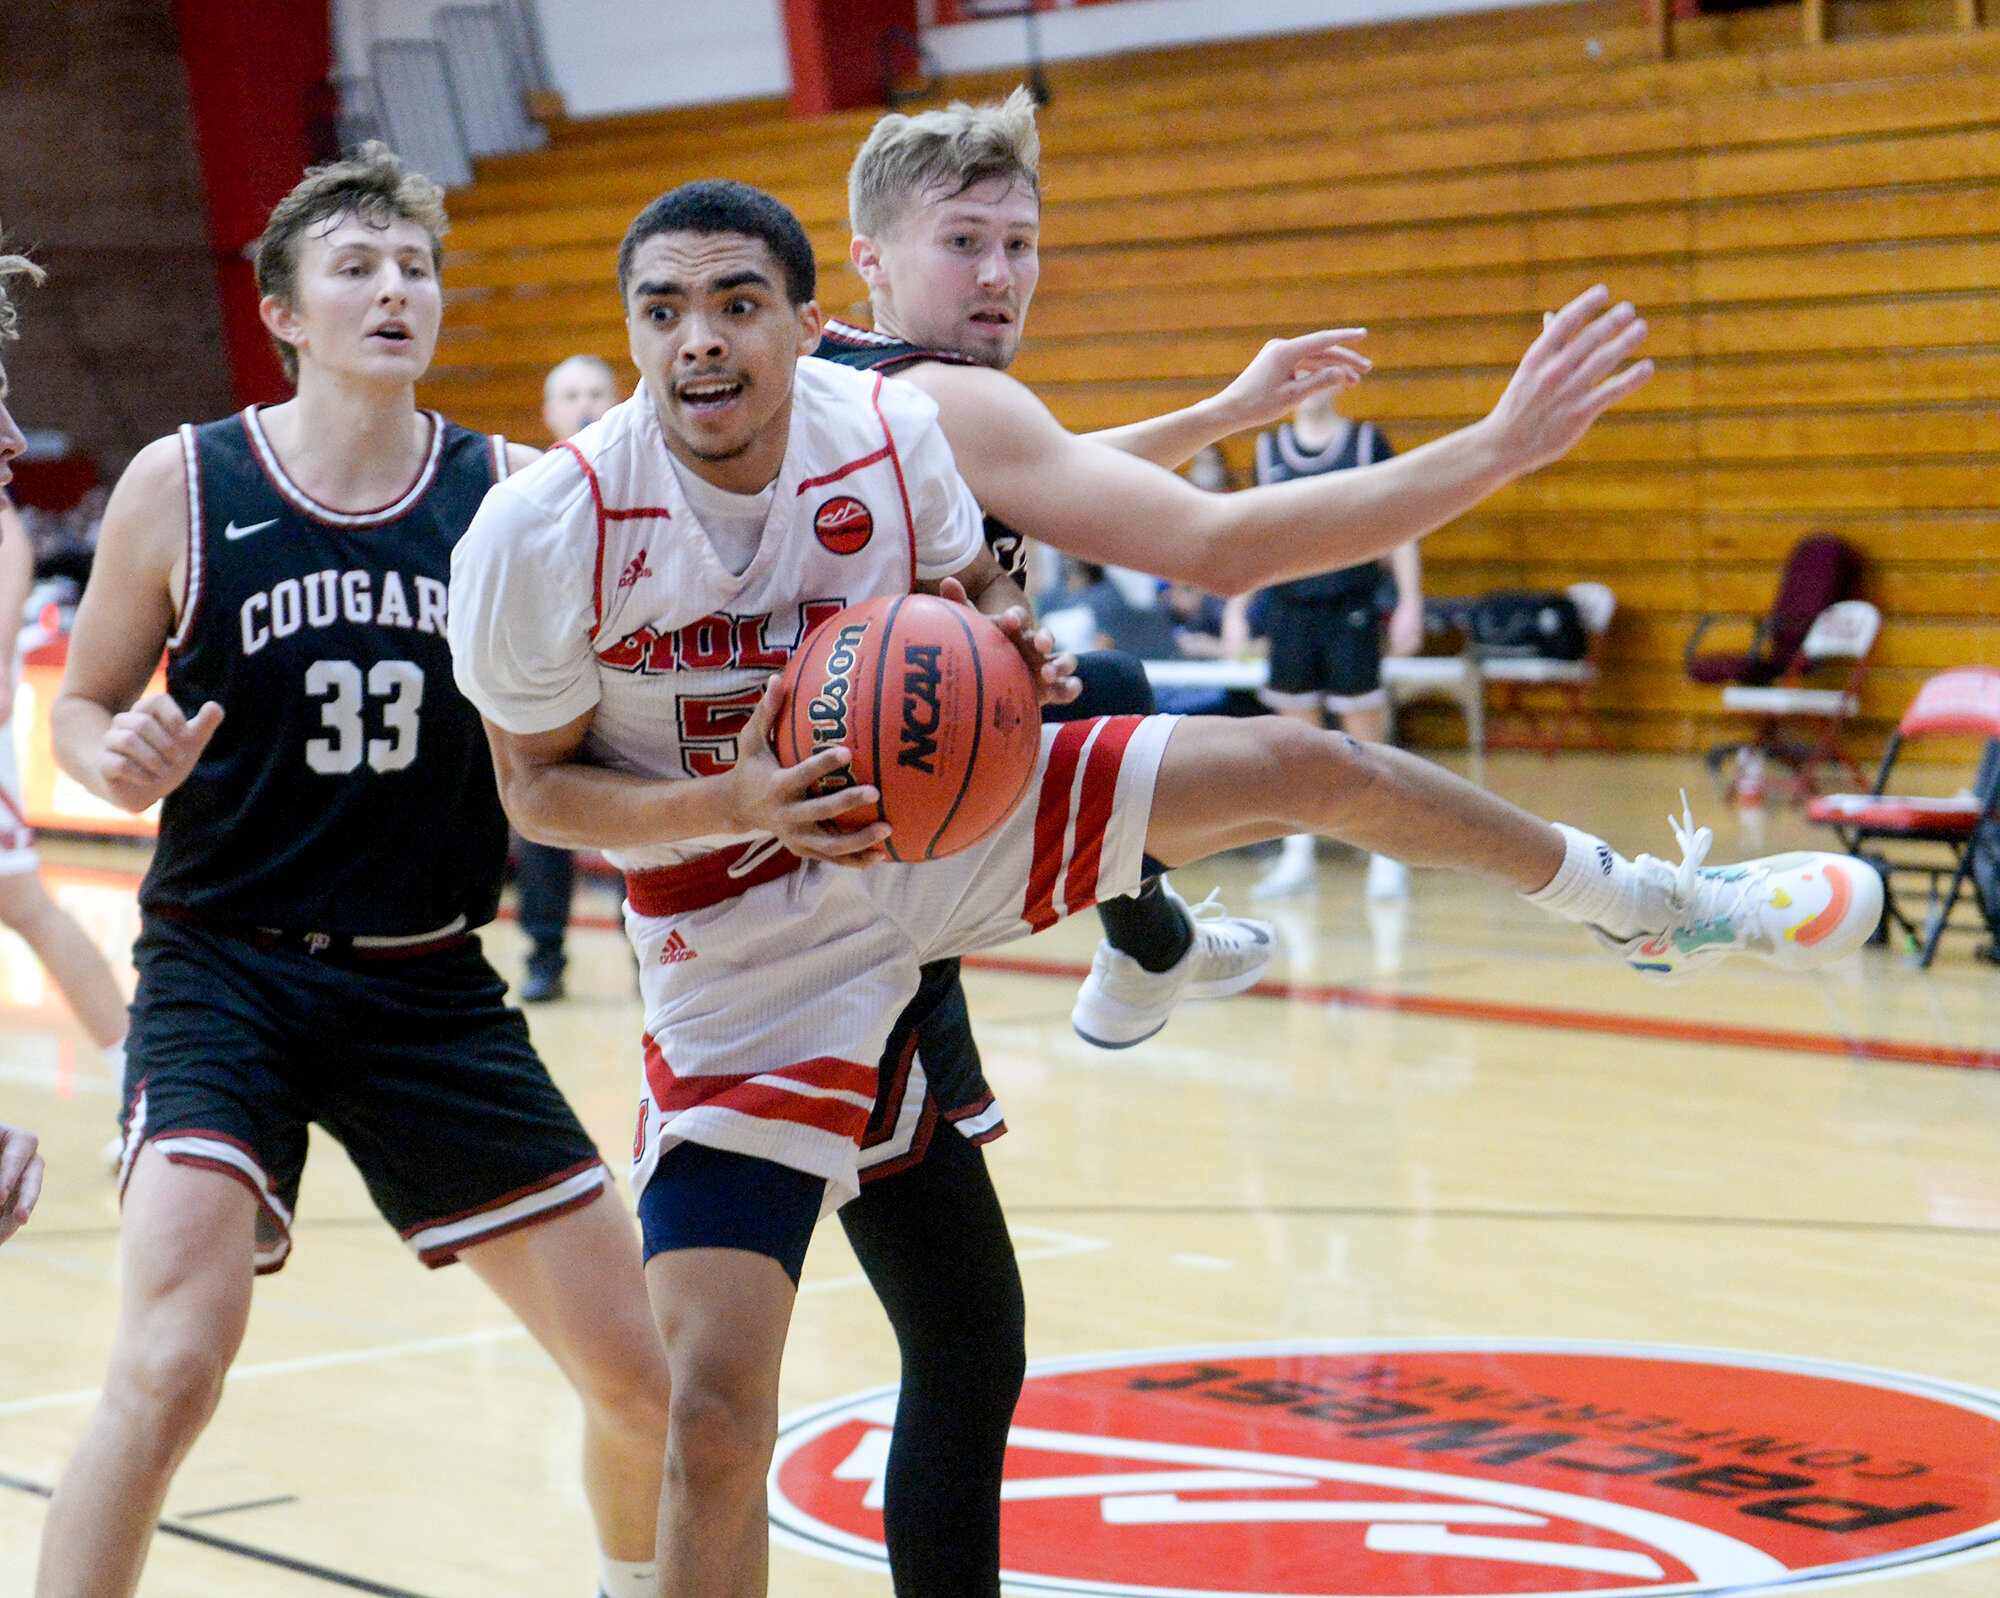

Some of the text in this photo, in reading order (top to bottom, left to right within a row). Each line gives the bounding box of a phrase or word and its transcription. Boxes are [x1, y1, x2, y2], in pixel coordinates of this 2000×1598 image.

[304, 659, 425, 775] 33
[897, 644, 942, 775] NCAA
[659, 949, 699, 966] adidas
